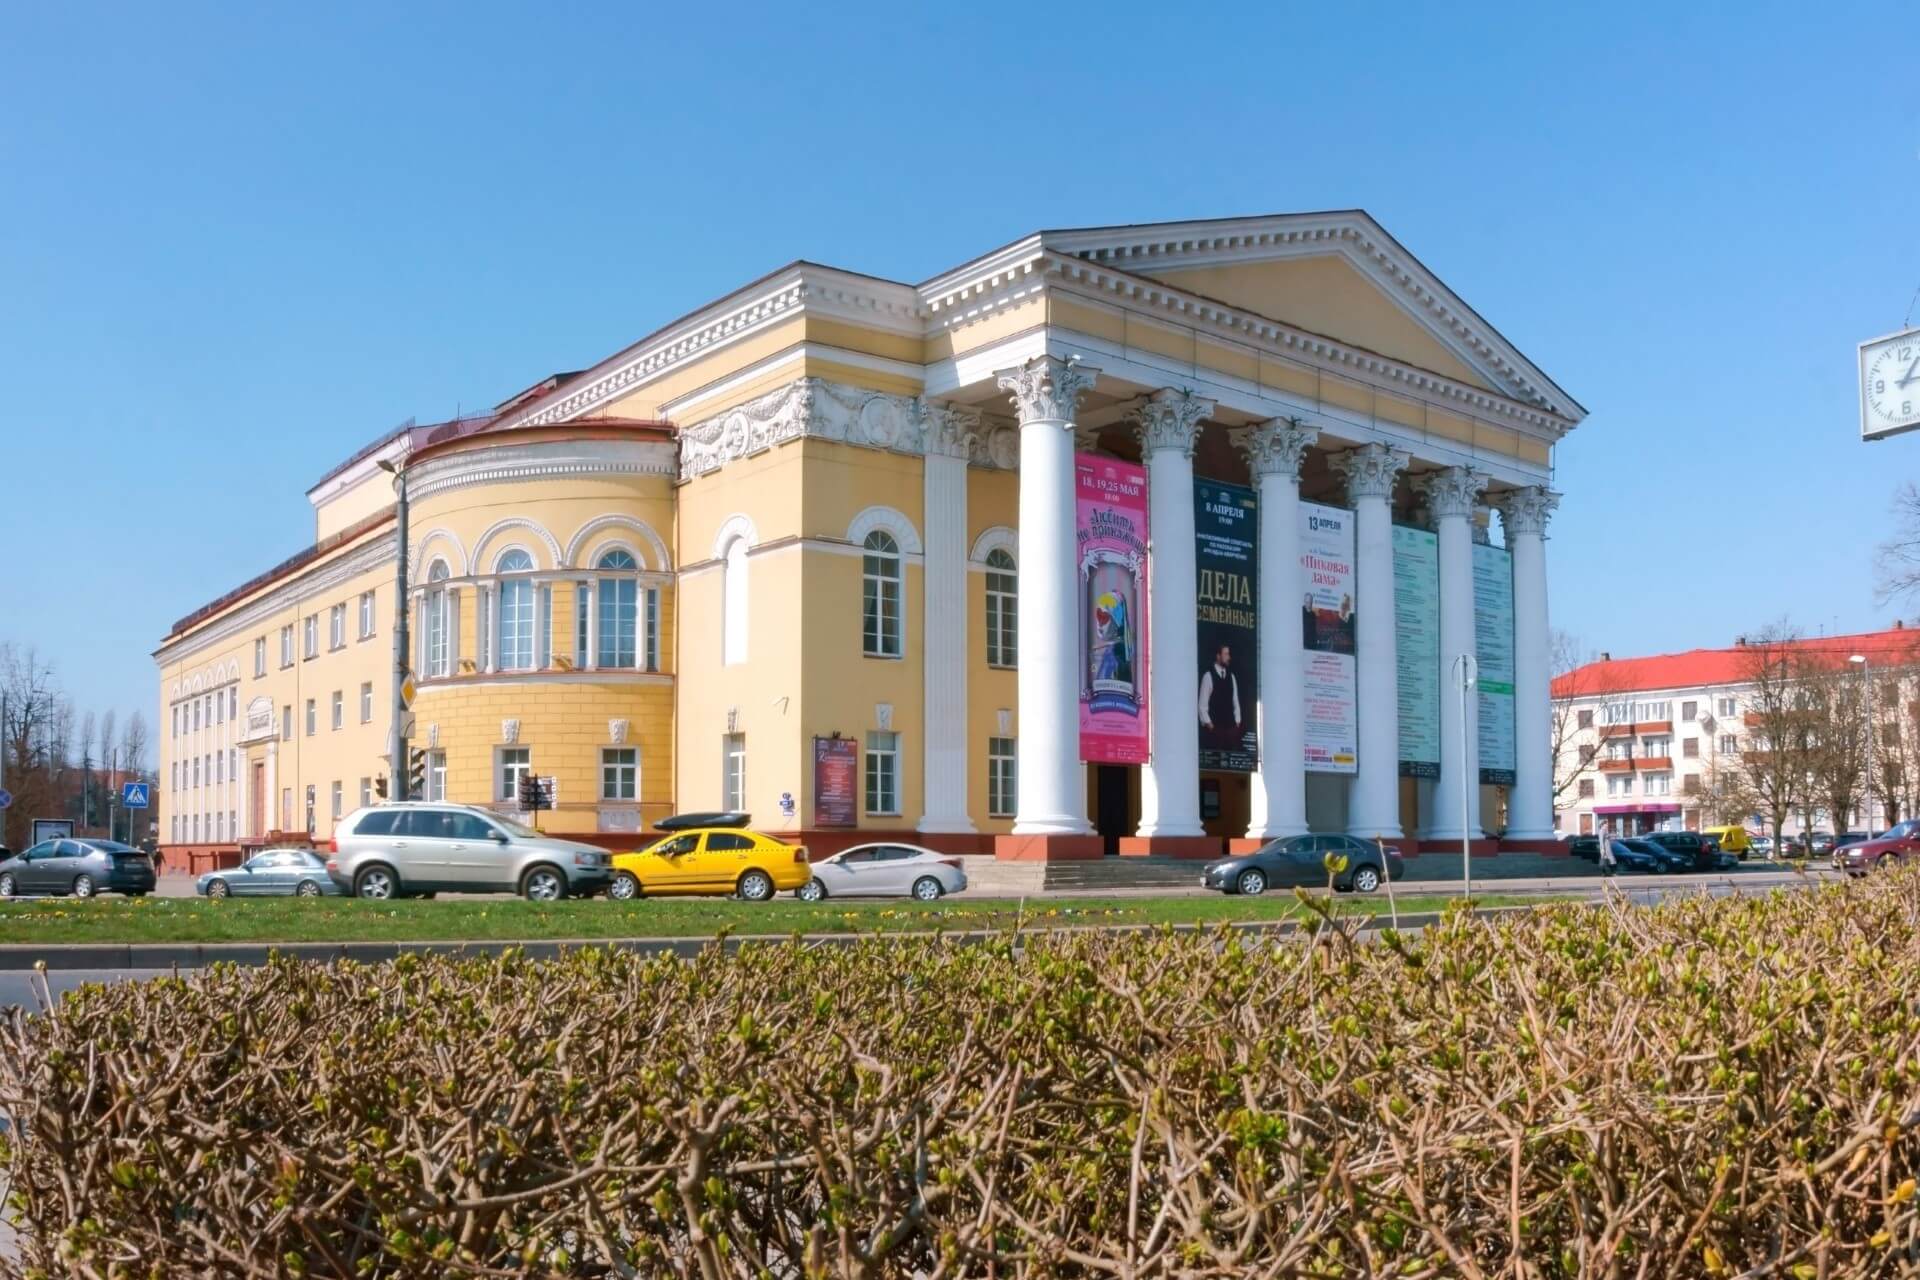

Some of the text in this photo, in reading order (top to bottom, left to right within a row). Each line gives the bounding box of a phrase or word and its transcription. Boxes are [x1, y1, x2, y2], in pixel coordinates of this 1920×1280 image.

[1898, 346, 1912, 362] 12
[1875, 380, 1885, 394] 9
[1902, 400, 1911, 415] 6
[1119, 484, 1139, 497] МАЯ
[1206, 501, 1212, 513] 8
[1212, 503, 1244, 520] АПРЕЛЯ
[1308, 516, 1342, 531] 13 АПРЕЛЯ
[1199, 568, 1252, 606] ДЕЛА
